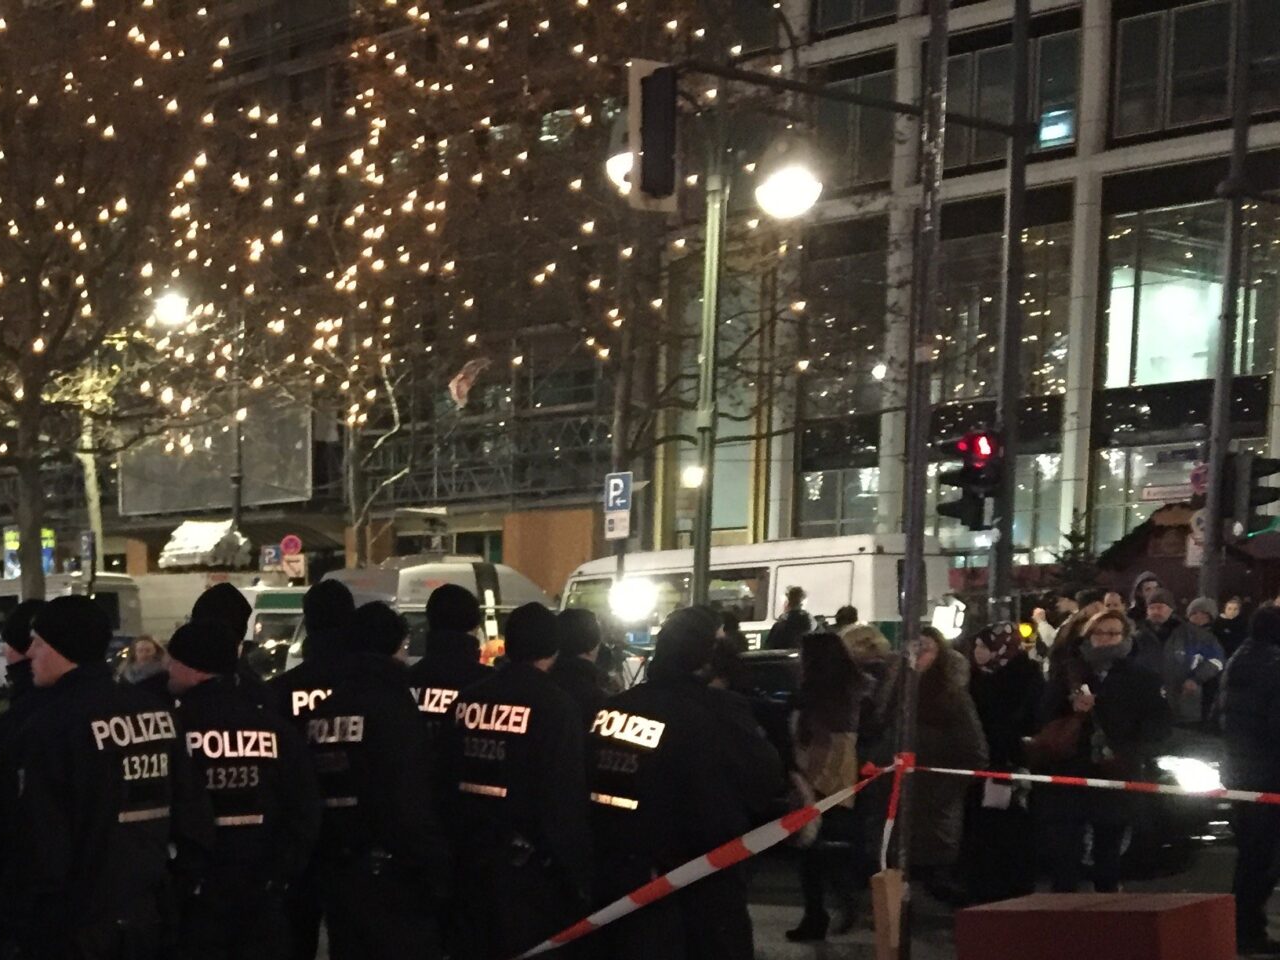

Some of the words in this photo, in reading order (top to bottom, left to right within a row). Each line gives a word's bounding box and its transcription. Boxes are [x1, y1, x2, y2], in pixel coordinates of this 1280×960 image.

[608, 478, 624, 507] P
[91, 711, 176, 750] POLIZEI
[455, 702, 531, 734] POLIZEI
[589, 709, 666, 749] POLIZEI
[186, 730, 277, 758] POLIZEI
[206, 765, 259, 789] 13233
